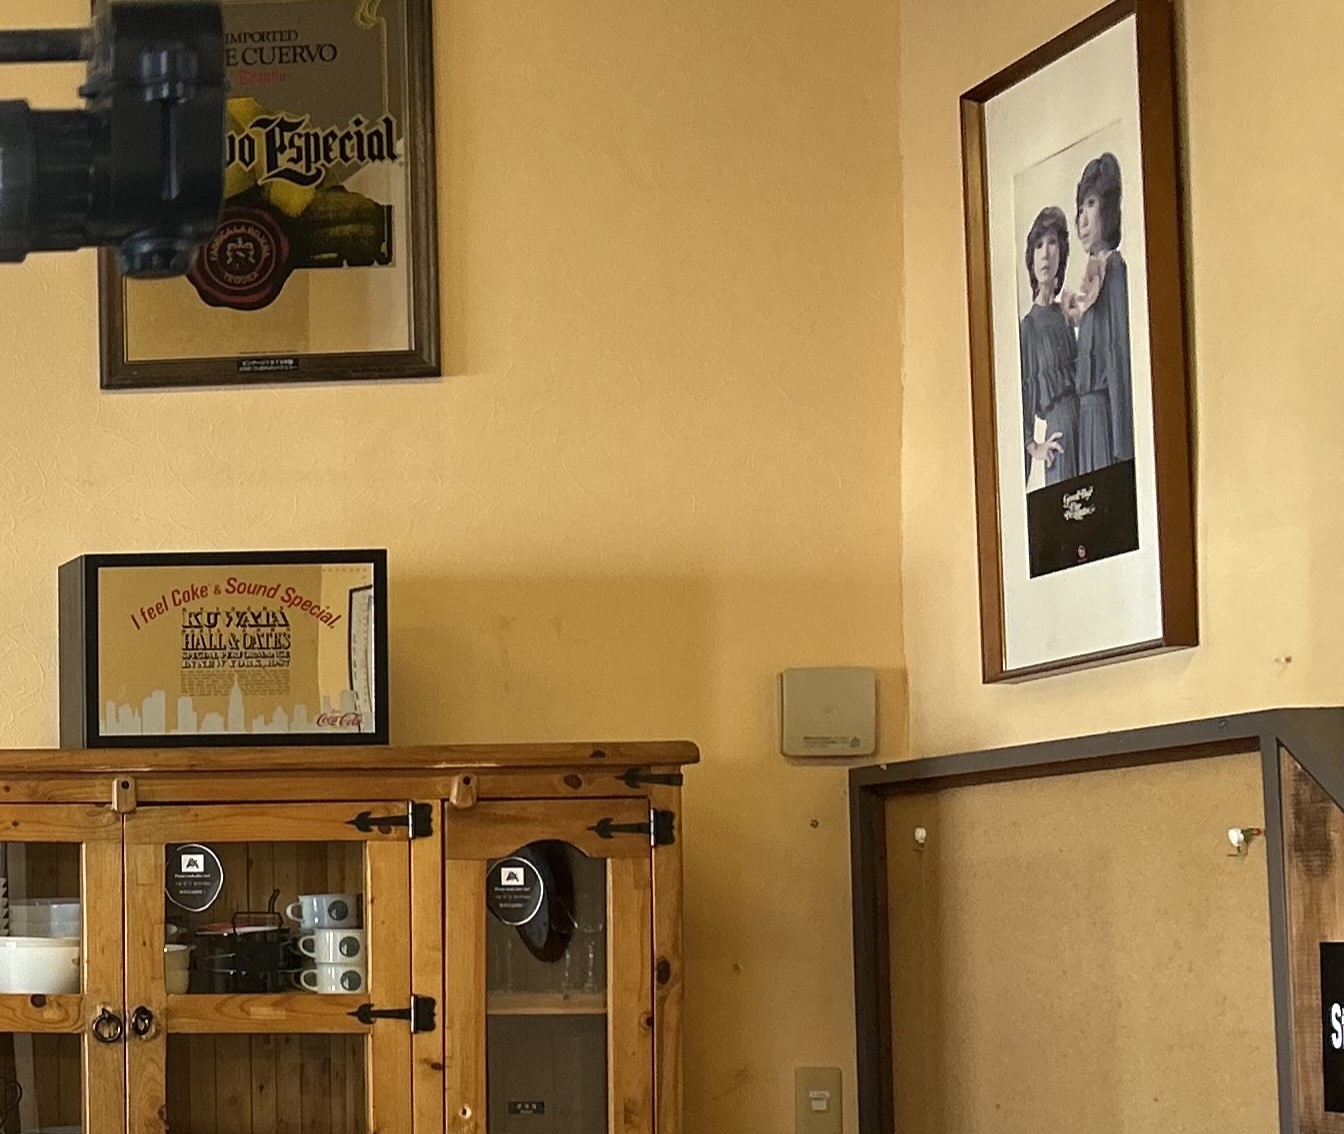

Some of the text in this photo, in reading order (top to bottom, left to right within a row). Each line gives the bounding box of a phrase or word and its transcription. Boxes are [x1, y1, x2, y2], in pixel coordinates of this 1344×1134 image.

[225, 29, 299, 44] IMPORTED
[241, 43, 338, 66] CUERVO
[250, 116, 398, 187] Especial
[131, 614, 141, 630] I
[140, 601, 169, 626] feel
[172, 583, 209, 607] Coke
[225, 577, 282, 600] Sound
[182, 632, 227, 650] HALL
[242, 632, 291, 650] OATES
